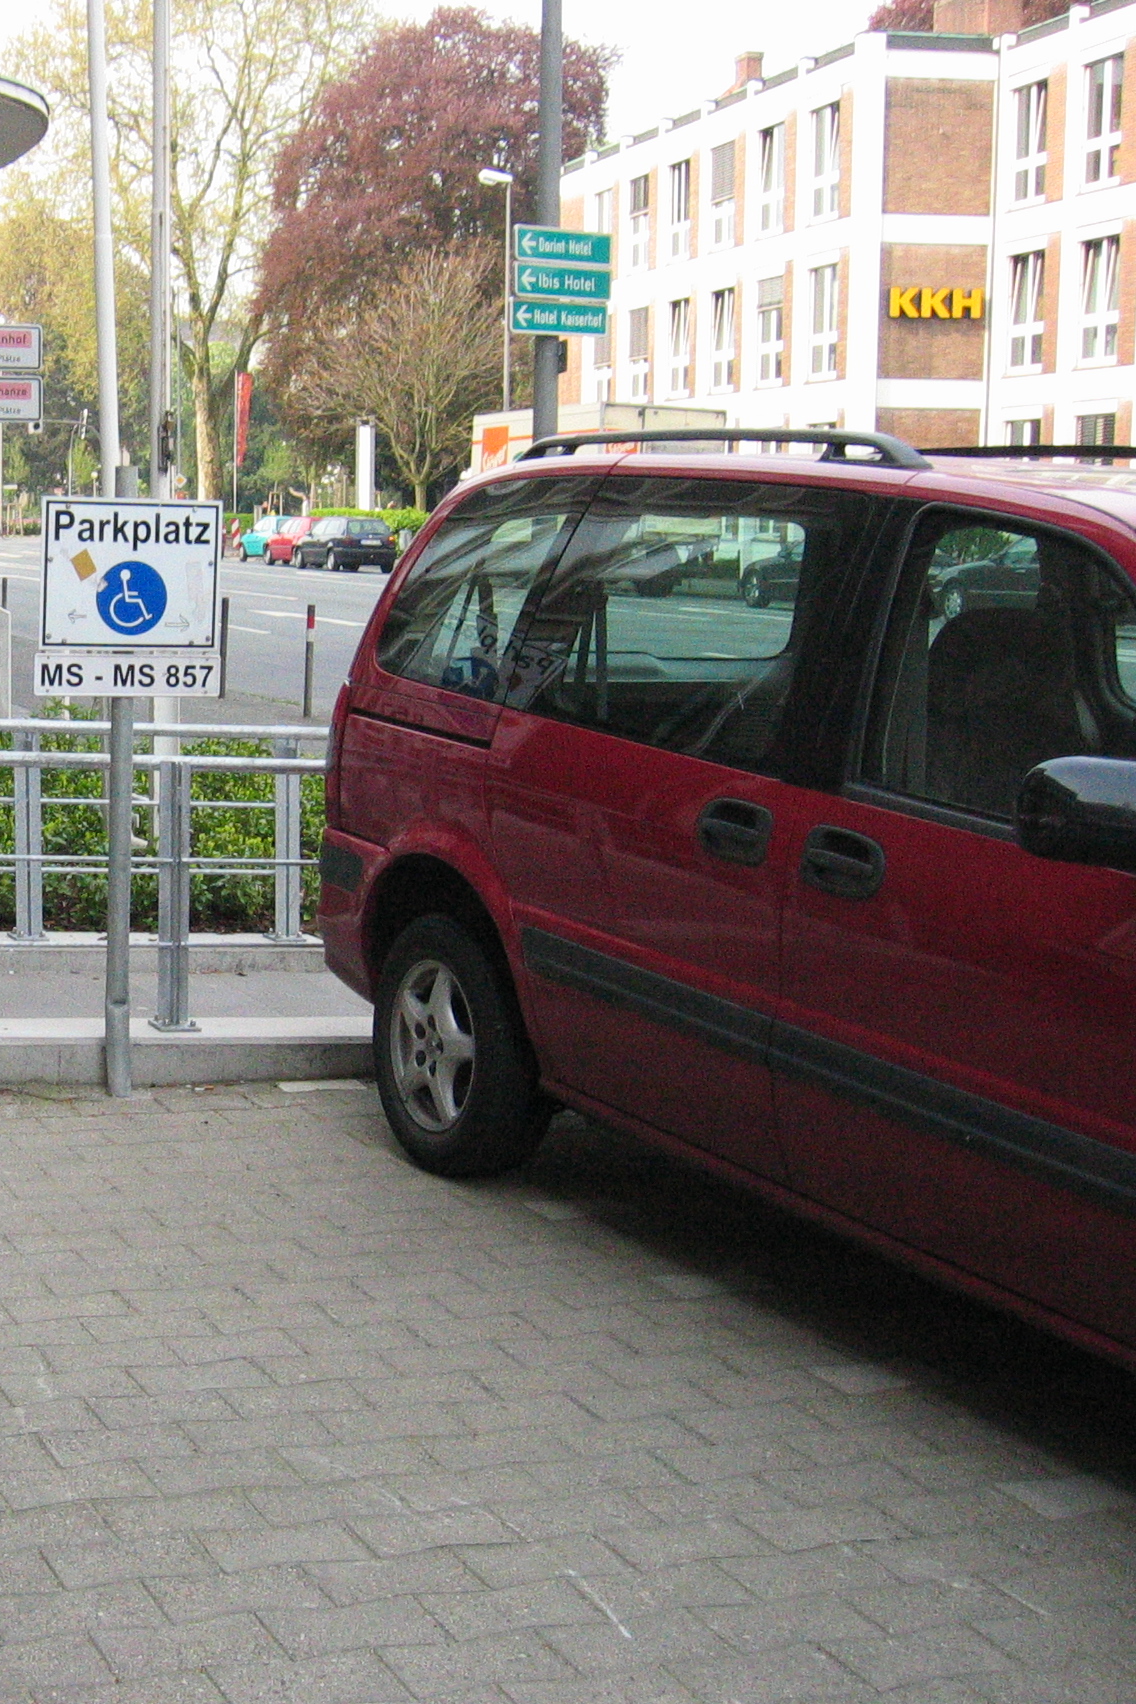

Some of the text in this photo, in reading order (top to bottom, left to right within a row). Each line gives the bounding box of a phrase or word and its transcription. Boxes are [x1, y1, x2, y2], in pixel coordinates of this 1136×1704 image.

[538, 236, 592, 256] Dorint Hotel
[538, 272, 596, 292] Ibis Hotel
[889, 286, 983, 319] KKH
[534, 308, 603, 328] Hotel Kaiserhof
[54, 510, 211, 551] Parkplatz
[40, 663, 84, 687] MS
[113, 663, 155, 687] MS
[165, 664, 214, 688] 857
